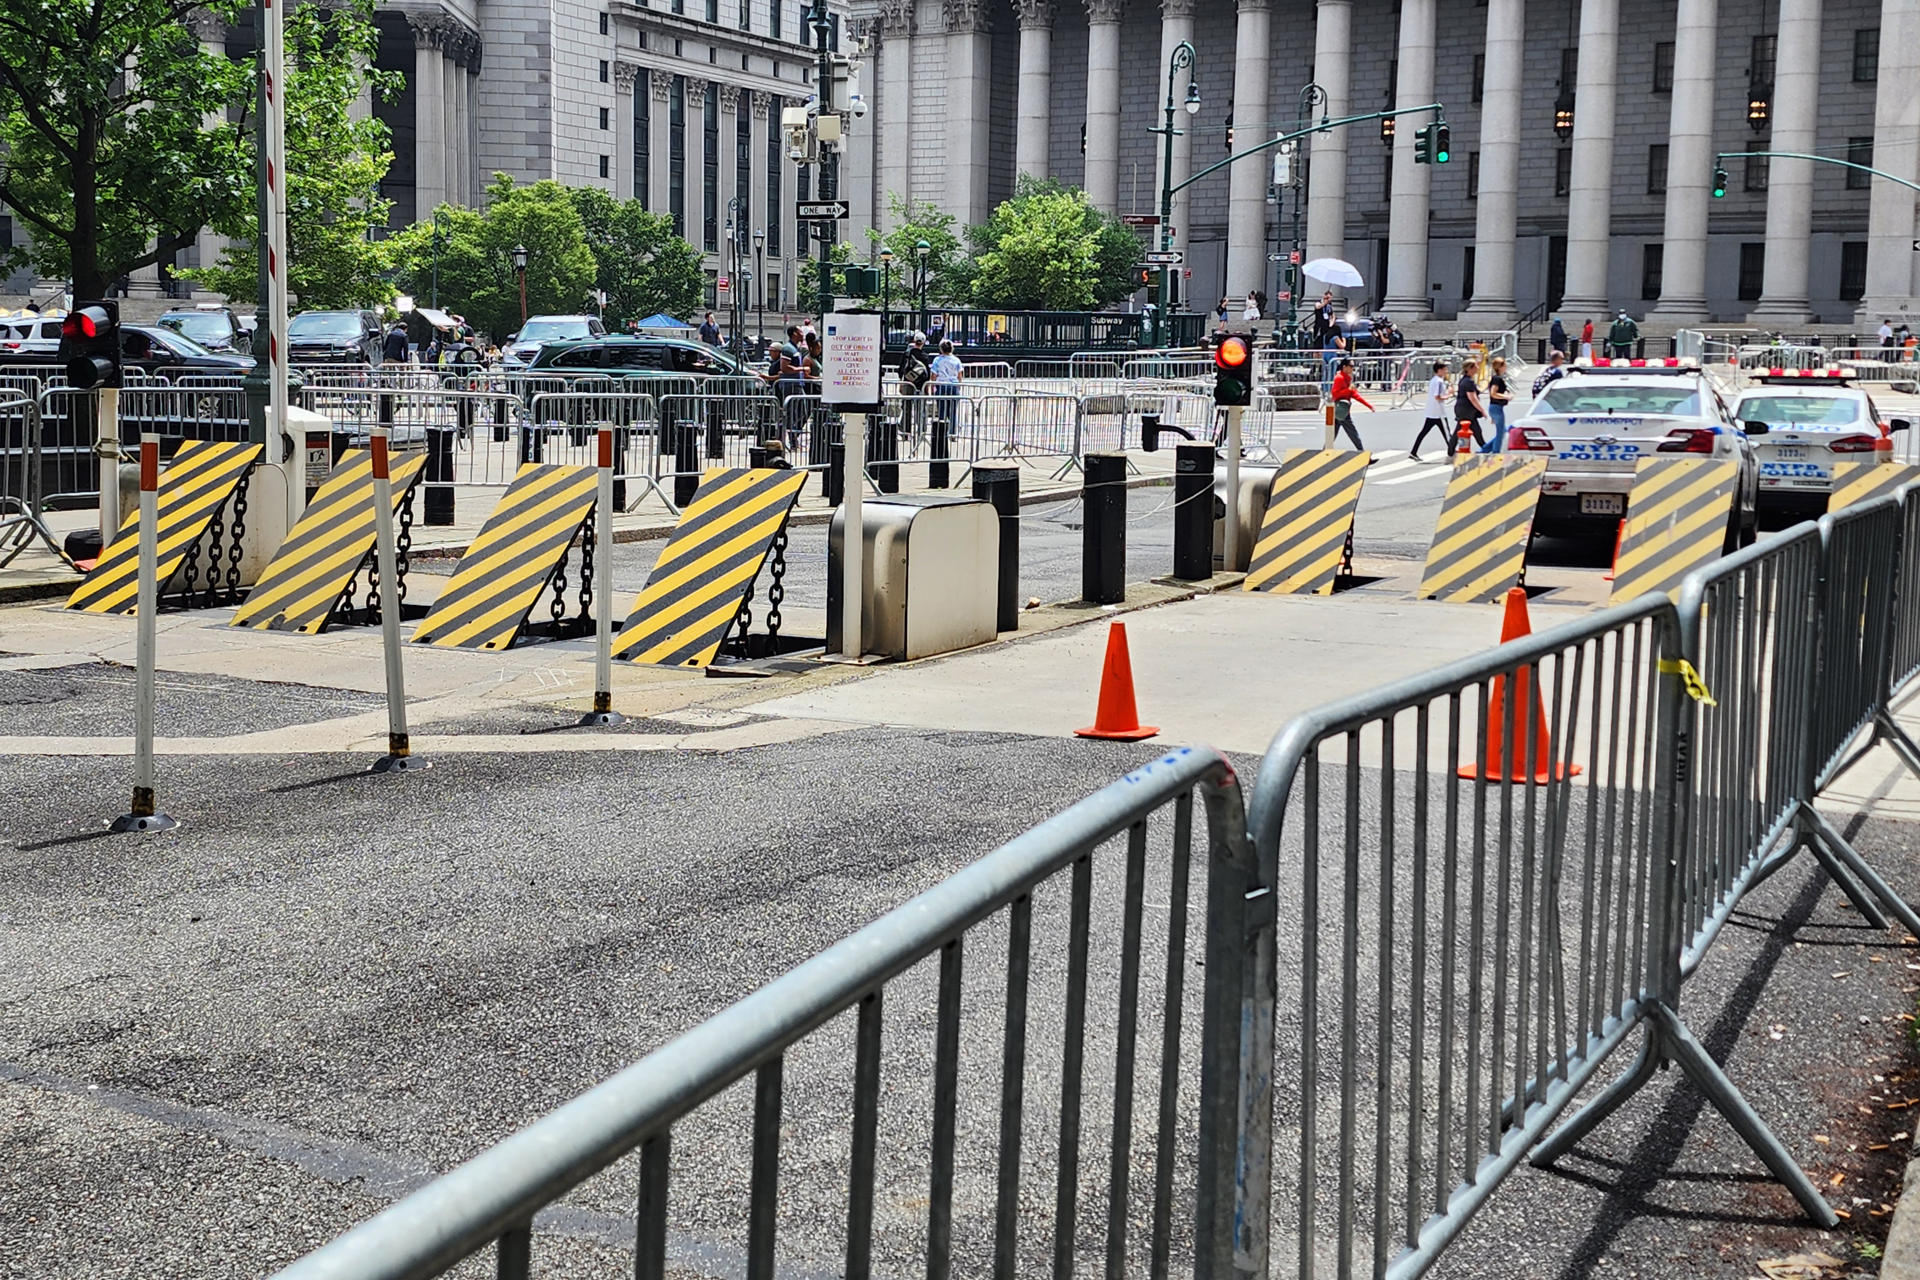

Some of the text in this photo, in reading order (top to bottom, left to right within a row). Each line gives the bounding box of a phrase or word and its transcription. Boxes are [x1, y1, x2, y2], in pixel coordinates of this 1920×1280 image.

[803, 206, 841, 214] ONE WAY
[1091, 316, 1123, 325] Subway
[1570, 444, 1640, 452] NYPD
